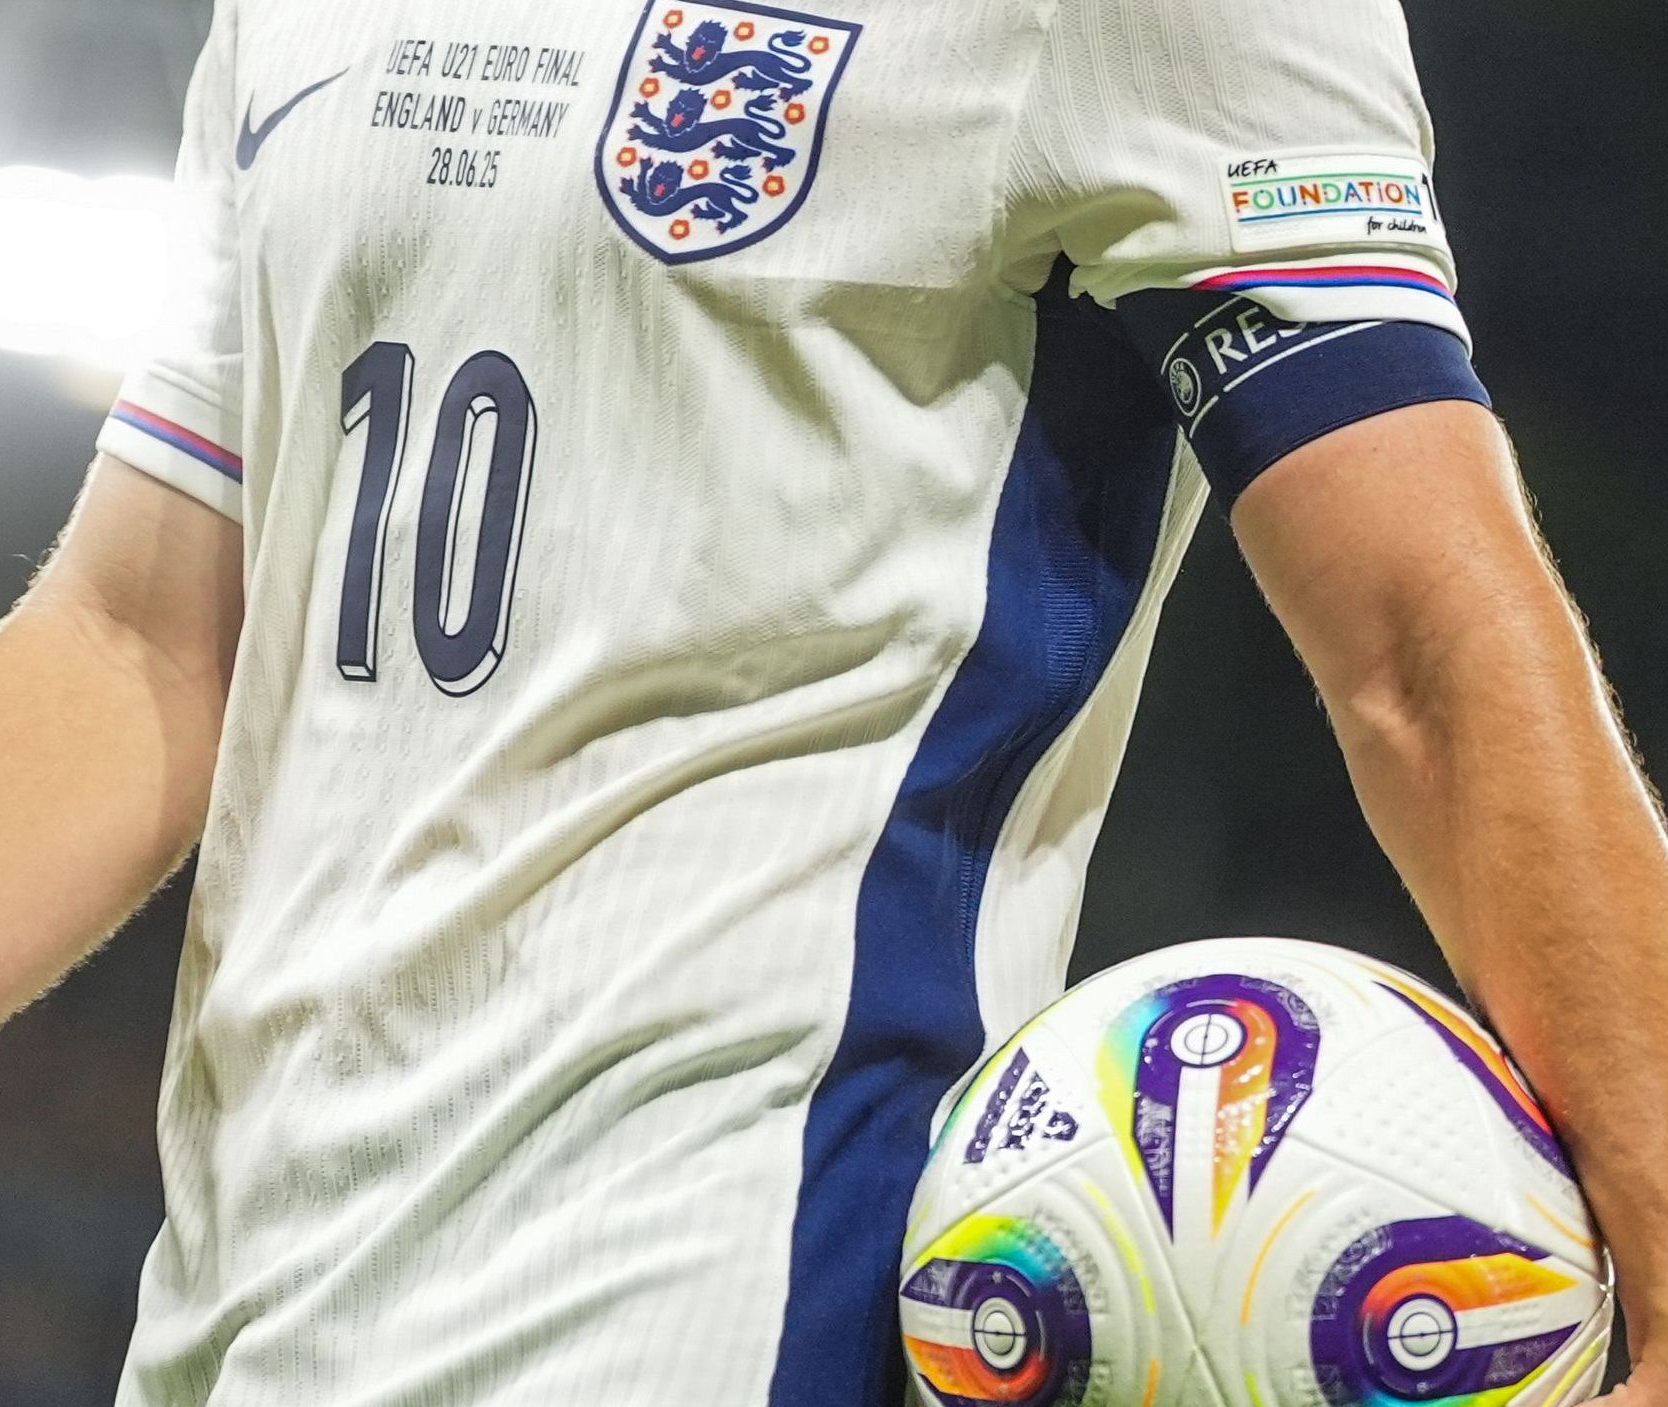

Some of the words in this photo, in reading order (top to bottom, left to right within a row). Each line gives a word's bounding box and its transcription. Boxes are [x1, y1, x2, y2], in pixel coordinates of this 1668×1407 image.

[386, 40, 434, 76] UEFA
[442, 42, 479, 80] U21
[481, 45, 531, 82] EURO
[532, 48, 584, 86] FINAL
[371, 91, 466, 133] ENGLAND
[471, 108, 483, 134] v
[487, 99, 570, 138] GERMANY
[427, 147, 501, 188] 28.06.25
[1228, 159, 1278, 178] UEFA
[1232, 182, 1421, 213] FOUNDATION
[1367, 216, 1383, 235] for
[337, 341, 538, 697] 10
